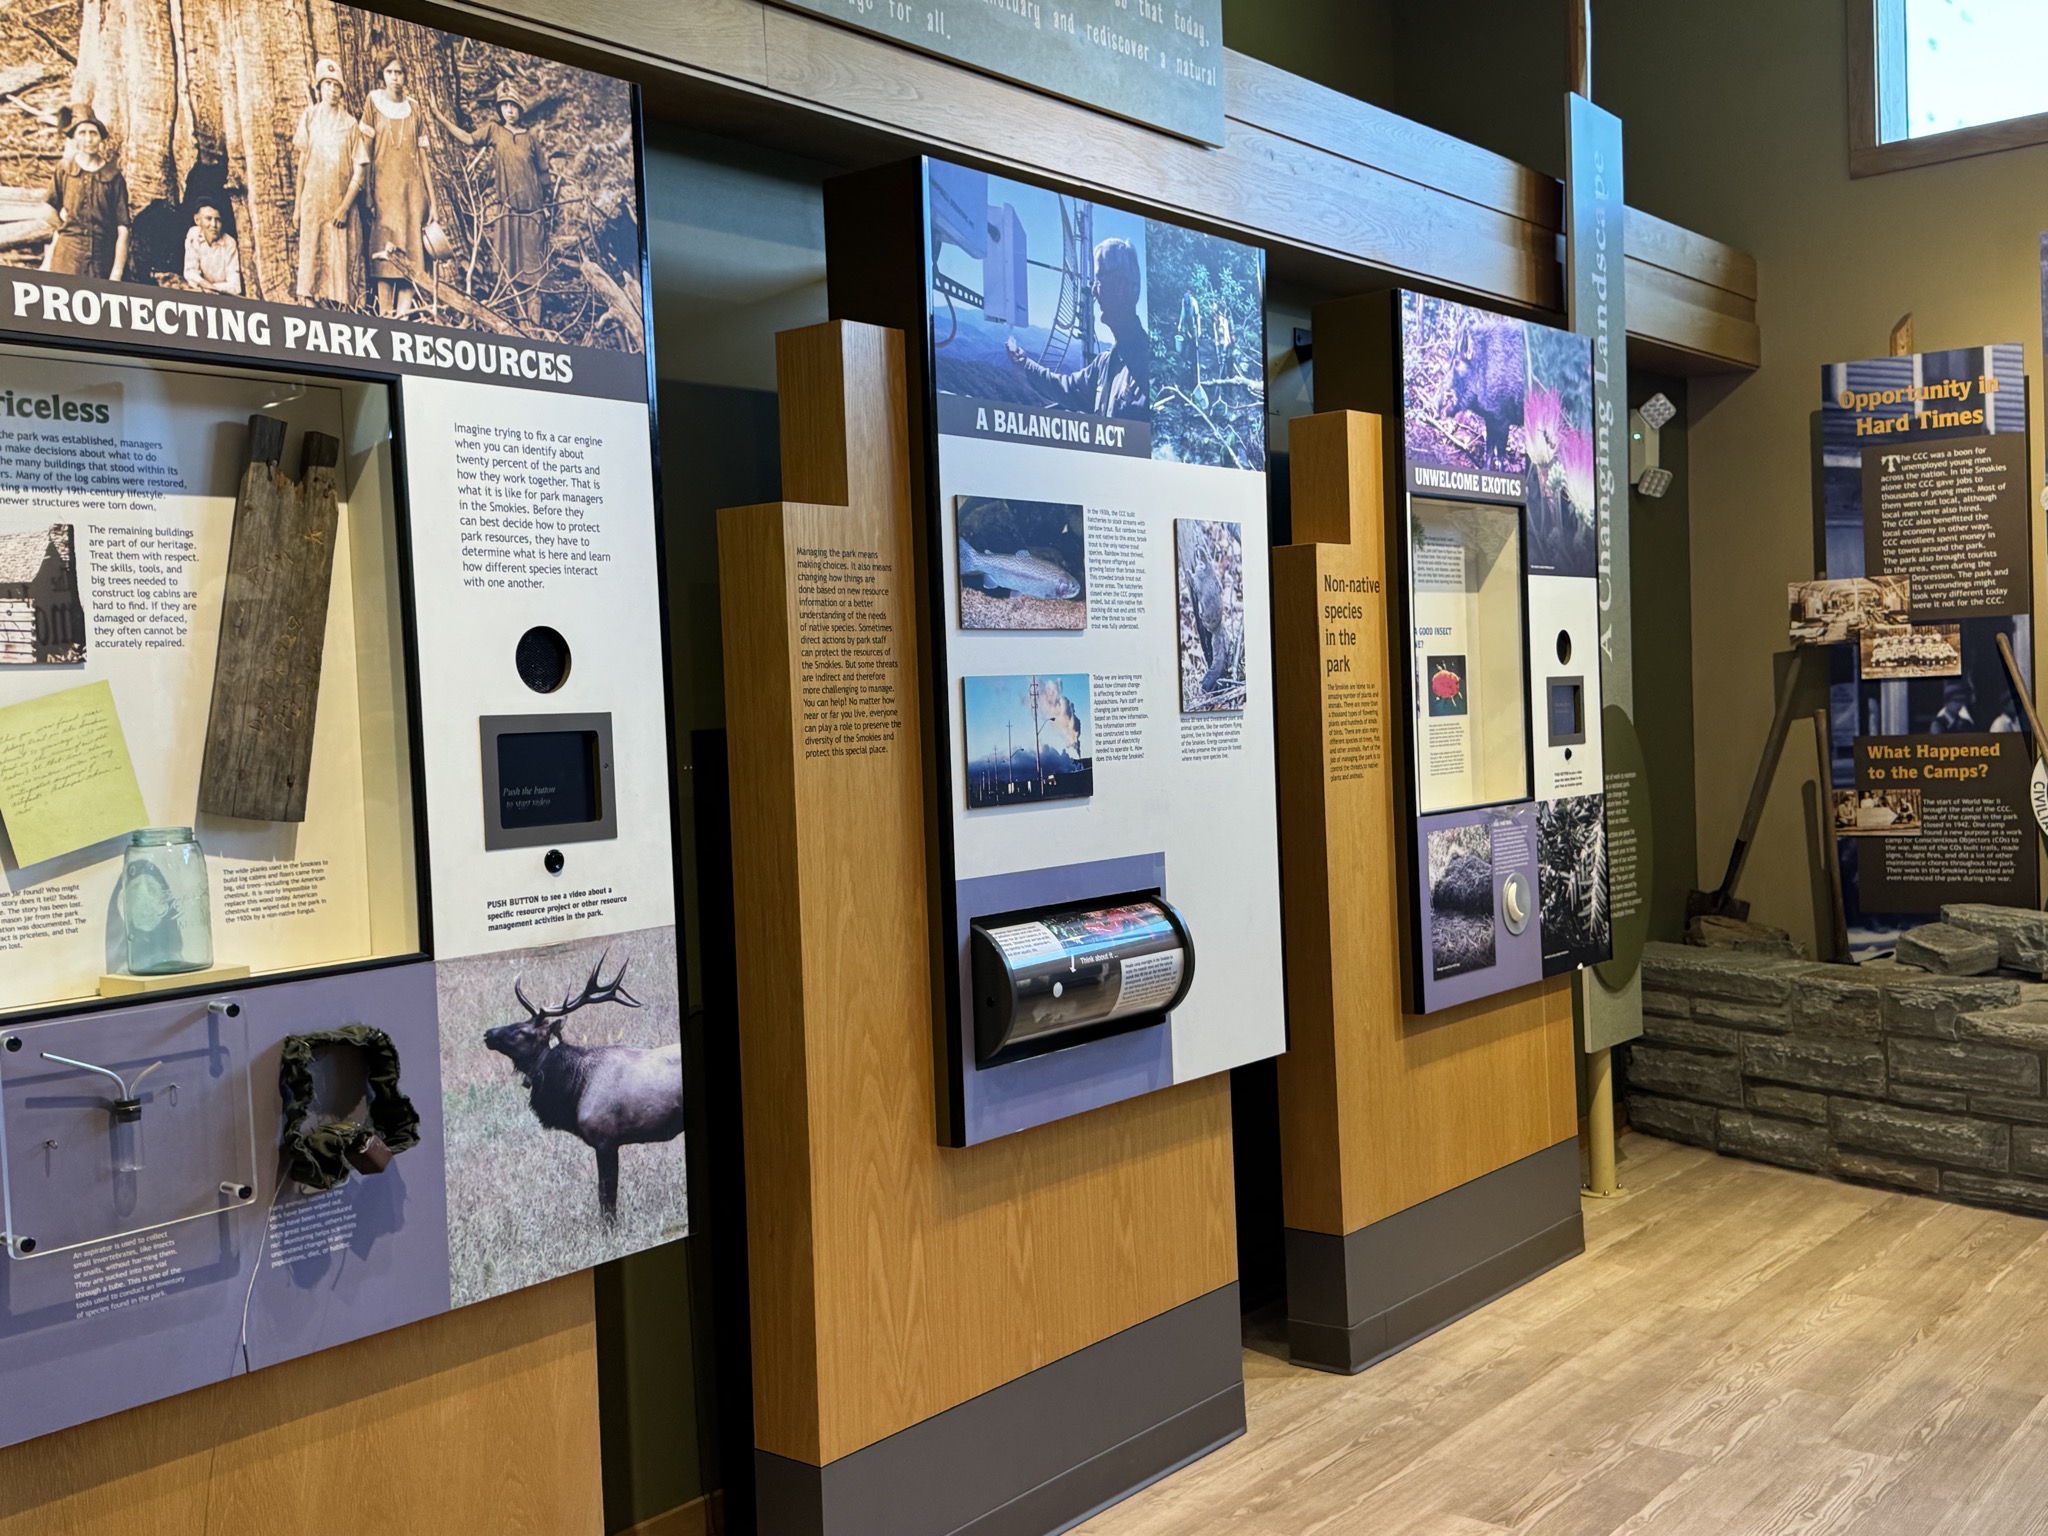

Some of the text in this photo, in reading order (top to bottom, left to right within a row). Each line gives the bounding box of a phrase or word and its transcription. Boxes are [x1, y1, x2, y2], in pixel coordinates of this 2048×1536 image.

[888, 0, 912, 23] for
[928, 8, 951, 40] all.
[1174, 10, 1210, 48] today,
[1054, 10, 1074, 34] and
[1086, 23, 1149, 62] rediscover
[1160, 52, 1166, 69] a
[1176, 56, 1216, 88] natural
[12, 281, 573, 384] PROTECTING PARK RESOURCES
[1840, 375, 1999, 413] Opportunity in
[1592, 150, 1614, 662] A Changing Landscape
[976, 407, 1125, 448] A BALANCING ACT
[1856, 408, 1984, 436] Hard Times
[17, 431, 38, 442] park
[62, 434, 117, 447] established,
[120, 440, 162, 450] managers
[454, 422, 491, 436] Imagine
[494, 427, 521, 441] trying
[524, 430, 534, 439] to
[536, 430, 547, 441] fix
[574, 435, 602, 448] engine
[455, 438, 584, 459] when you can identify about
[456, 454, 600, 474] twenty percent of the parts and
[1902, 459, 1947, 470] unemployed
[1949, 459, 1972, 467] young
[1975, 464, 2006, 472] Smokies
[1415, 467, 1521, 496] UNWELCOME EXOTICS
[88, 524, 194, 539] The remaining buildings
[107, 539, 126, 548] part
[128, 538, 137, 547] of
[158, 539, 196, 551] heritage.
[797, 546, 828, 558] Managing
[829, 548, 840, 556] the
[842, 548, 856, 559] park
[1324, 574, 1380, 594] Non-native
[1324, 602, 1362, 623] species
[1326, 628, 1356, 646] in the
[1326, 655, 1350, 677] park
[803, 698, 815, 706] You
[830, 696, 847, 708] help!
[849, 696, 857, 705] No
[859, 697, 880, 705] matter
[882, 695, 895, 704] how
[1867, 742, 2000, 761] What Happened
[1868, 763, 1989, 782] to the Camps?
[487, 898, 507, 908] PUSH
[510, 894, 538, 905] BUTTON
[569, 889, 586, 898] video
[588, 887, 606, 895] about
[488, 909, 514, 922] specific
[516, 907, 545, 916] resource
[547, 902, 570, 914] project
[581, 898, 598, 907] other
[600, 896, 627, 904] resource
[488, 918, 532, 931] management
[534, 914, 564, 924] activities
[575, 911, 585, 919] the
[587, 908, 603, 919] park.
[1080, 956, 1094, 964] Think
[1095, 953, 1109, 962] about
